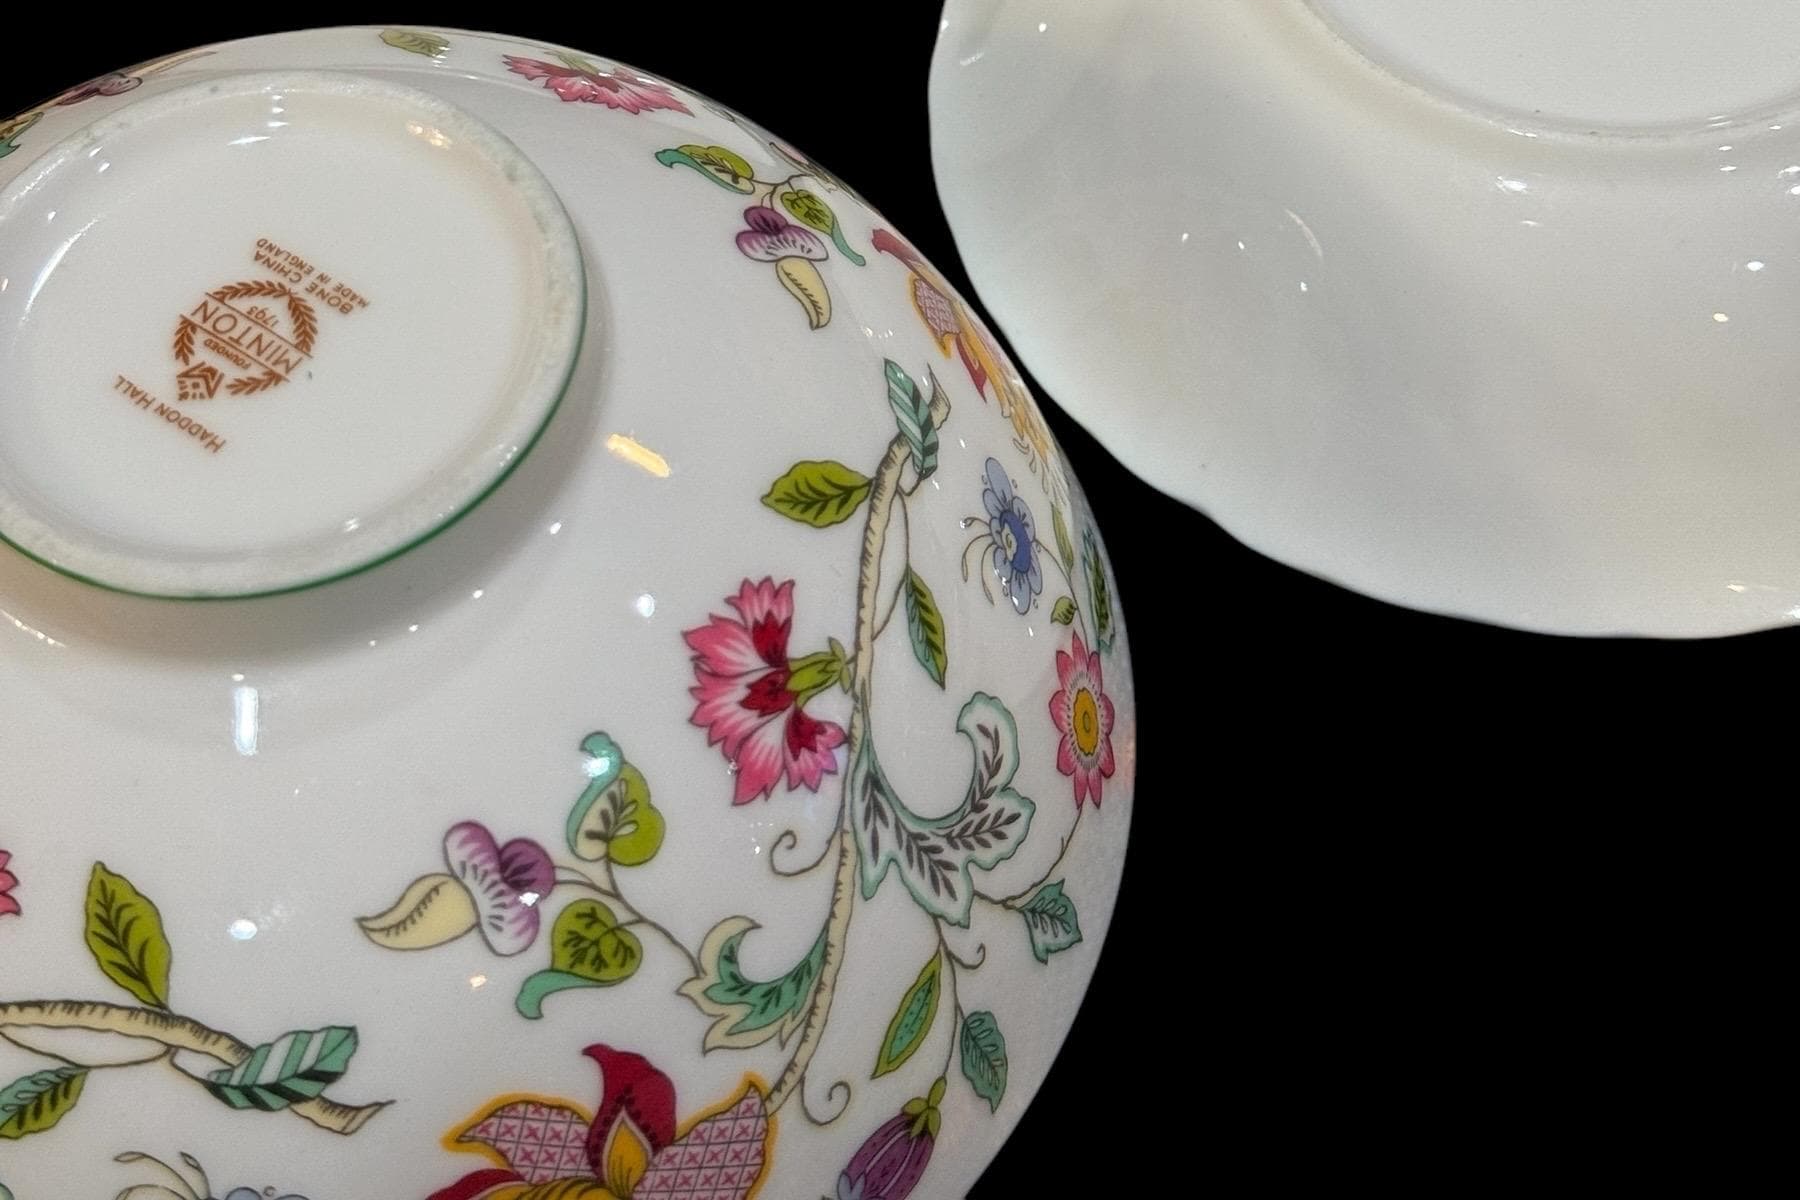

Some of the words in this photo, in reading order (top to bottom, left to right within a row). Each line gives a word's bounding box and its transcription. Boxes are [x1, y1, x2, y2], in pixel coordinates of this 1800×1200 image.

[253, 250, 302, 284] CHINA
[256, 237, 315, 273] ENGLAND
[317, 271, 331, 284] IN
[305, 283, 354, 315] BONE
[332, 282, 370, 308] MADE
[247, 305, 279, 327] 1793
[191, 300, 304, 374] MINTON
[203, 338, 252, 370] FOUNDED
[114, 374, 155, 410] HALL
[154, 402, 226, 453] HADDON
